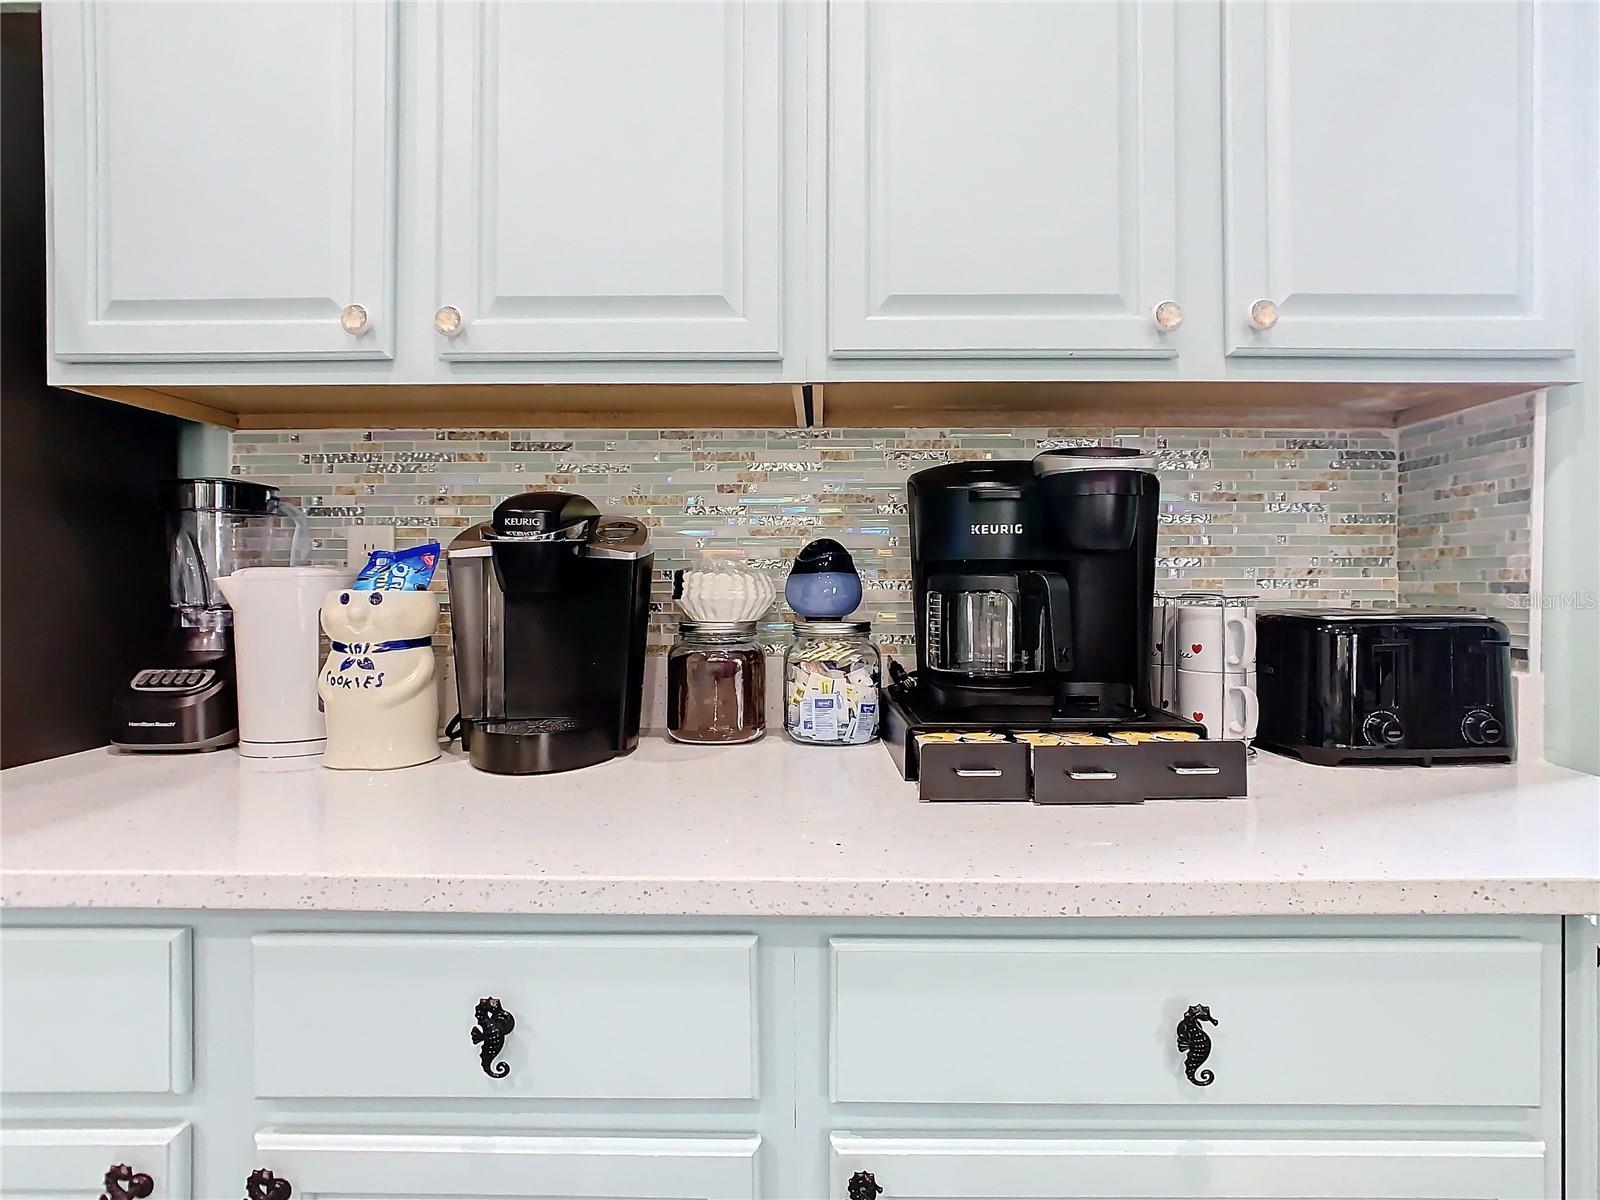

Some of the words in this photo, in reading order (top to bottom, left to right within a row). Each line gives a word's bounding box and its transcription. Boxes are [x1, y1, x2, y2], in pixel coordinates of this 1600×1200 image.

[504, 517, 540, 526] KEURIG
[970, 523, 1023, 535] KEURIG
[326, 670, 385, 689] COOKIES
